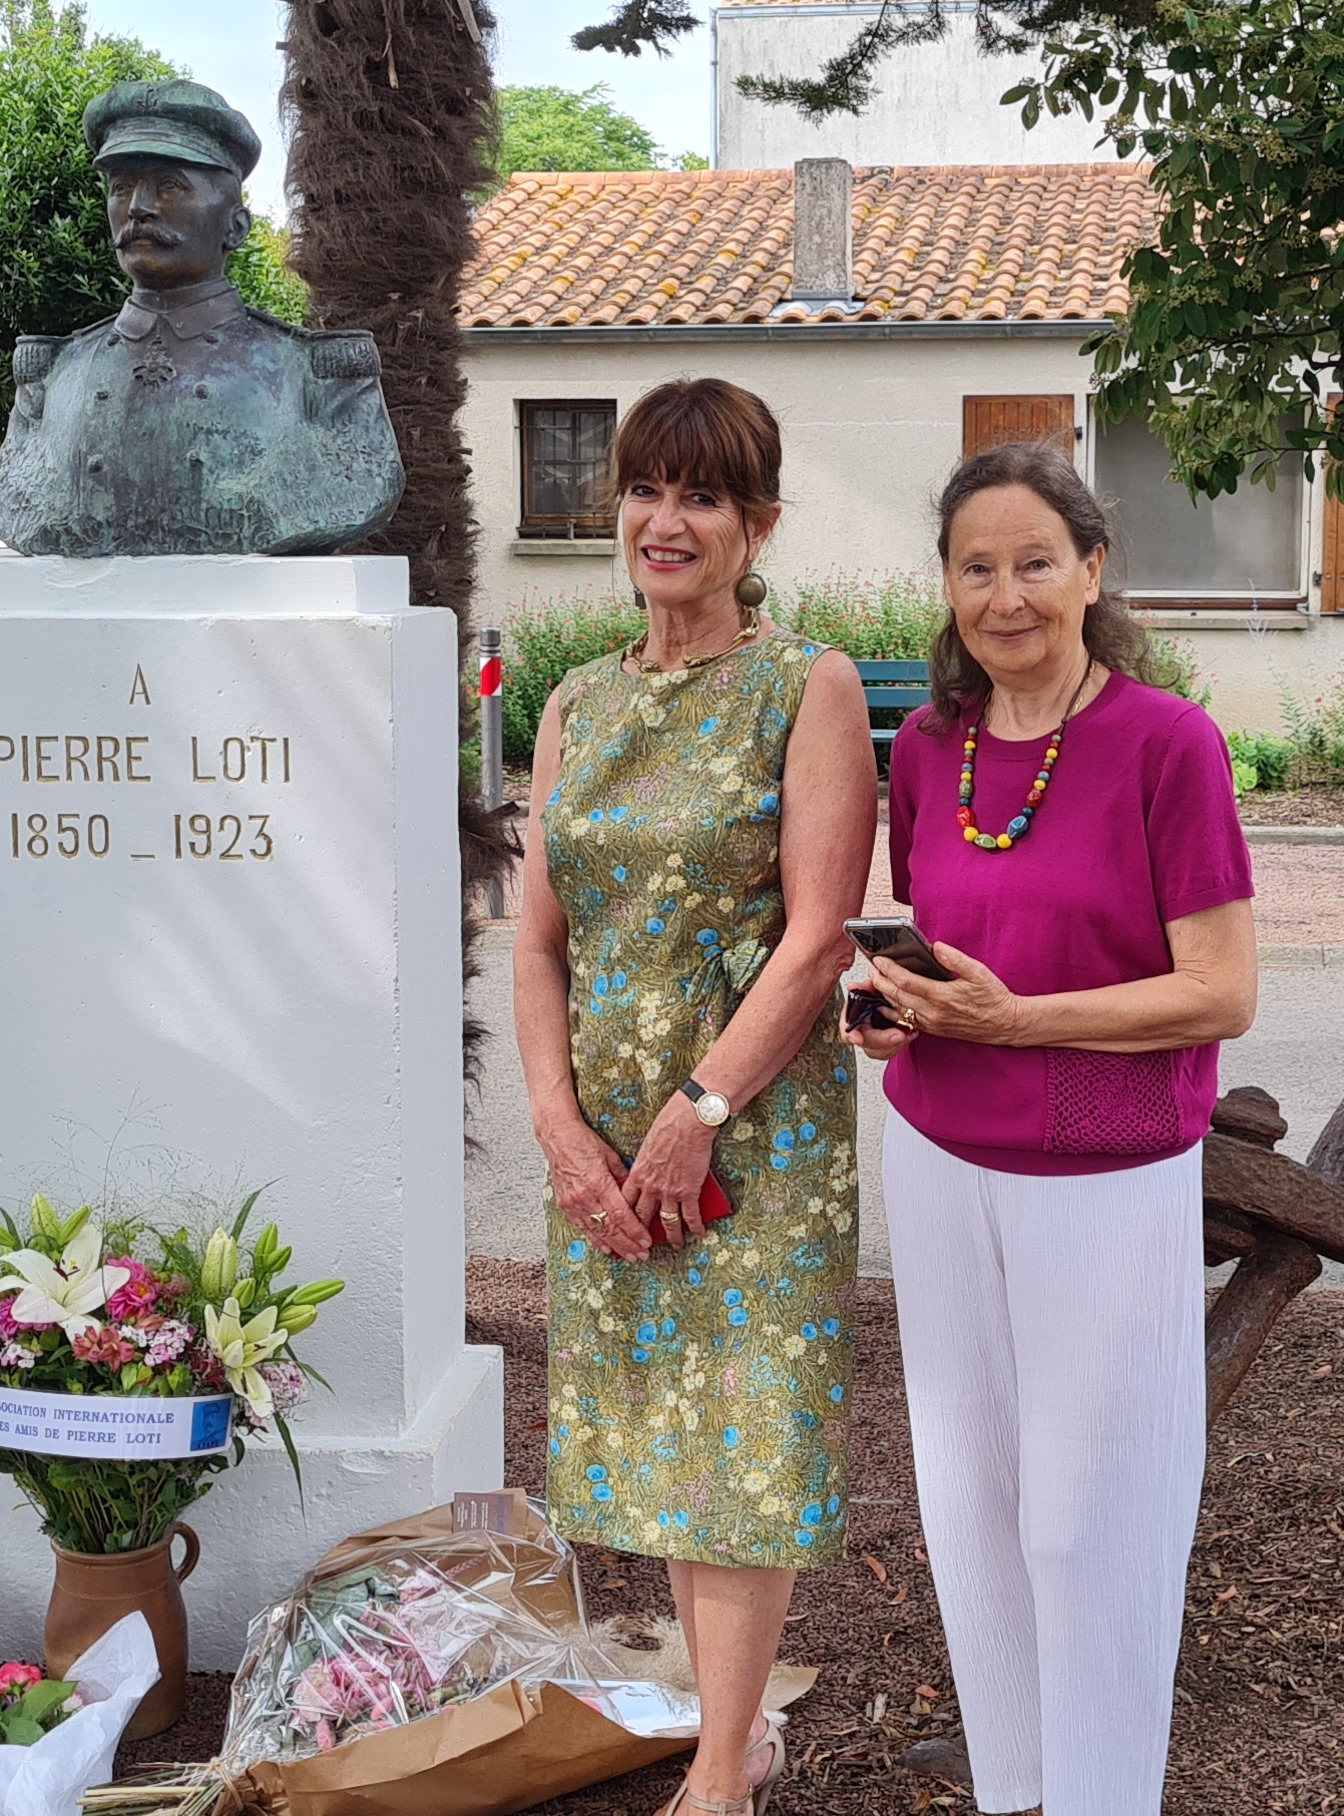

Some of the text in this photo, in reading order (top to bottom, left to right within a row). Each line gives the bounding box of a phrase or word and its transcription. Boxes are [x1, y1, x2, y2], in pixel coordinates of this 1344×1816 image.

[128, 663, 152, 706] A
[190, 735, 291, 784] LOTI
[11, 813, 111, 860] 1850
[173, 814, 275, 860] 1923
[15, 1423, 39, 1437] AMIS
[44, 1427, 60, 1440] DE
[67, 1430, 117, 1444] PIERRE
[125, 1432, 162, 1444] LOTI
[53, 1408, 175, 1424] INTERNATIONALE
